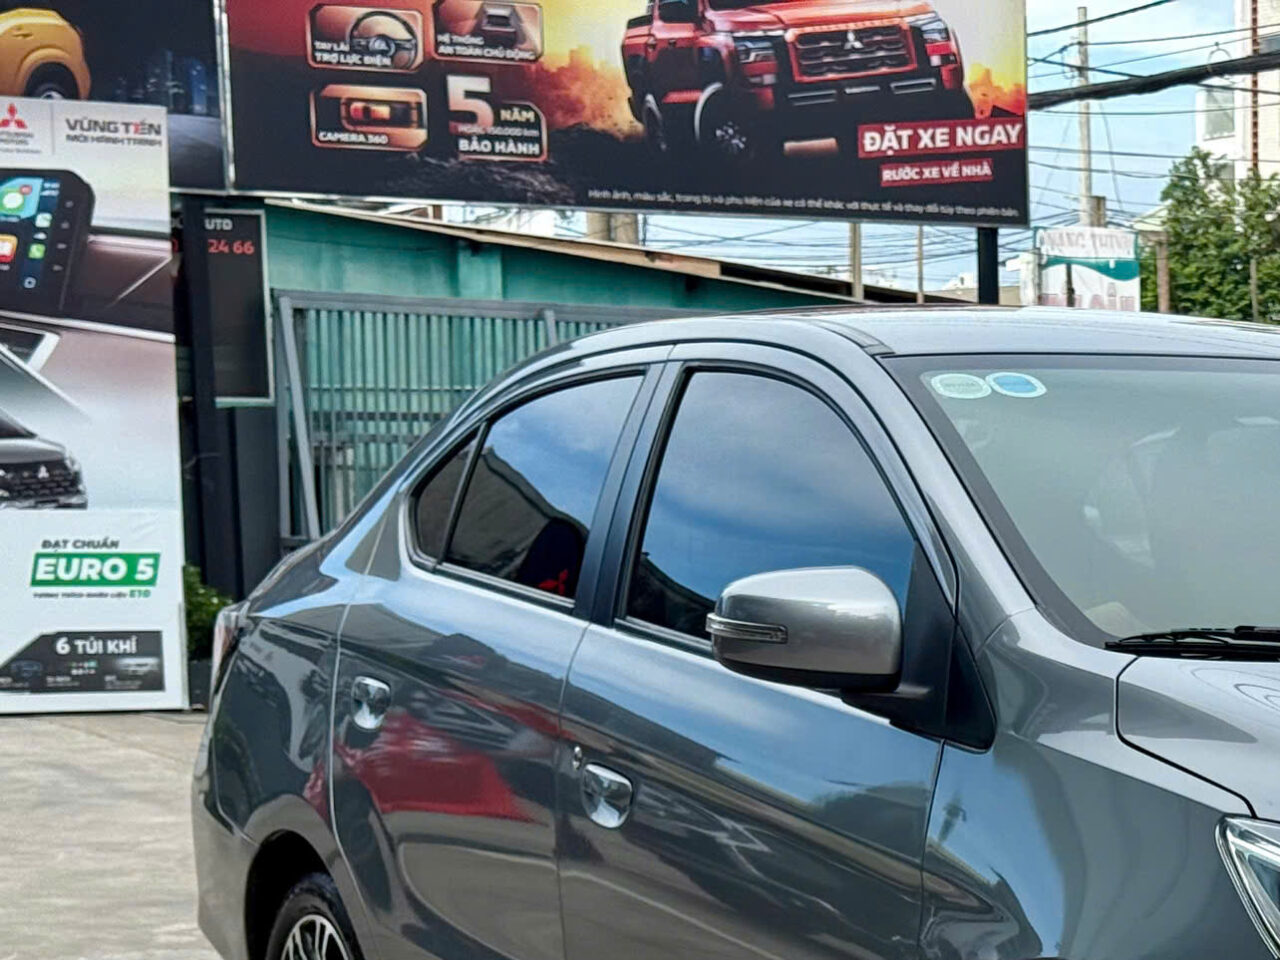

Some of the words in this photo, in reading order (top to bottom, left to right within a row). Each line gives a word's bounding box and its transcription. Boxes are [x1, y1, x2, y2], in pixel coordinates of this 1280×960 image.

[446, 75, 494, 135] 5
[500, 108, 535, 122] NĂM
[318, 131, 366, 144] CAMERA
[367, 135, 388, 145] 360
[458, 135, 492, 153] BẢO
[494, 138, 540, 156] HÀNH
[863, 124, 913, 156] ĐẶT
[917, 127, 950, 149] XE
[955, 123, 1023, 147] NGAY
[881, 166, 920, 182] RƯỚC
[922, 165, 940, 179] XE
[942, 161, 960, 178] VỀ
[961, 160, 992, 177] NHÀ
[205, 219, 233, 231] UTO
[35, 558, 128, 581] EURO
[134, 558, 155, 581] 5
[56, 637, 70, 655] 6
[74, 636, 103, 655] TÚI
[107, 635, 137, 654] KHÍ
